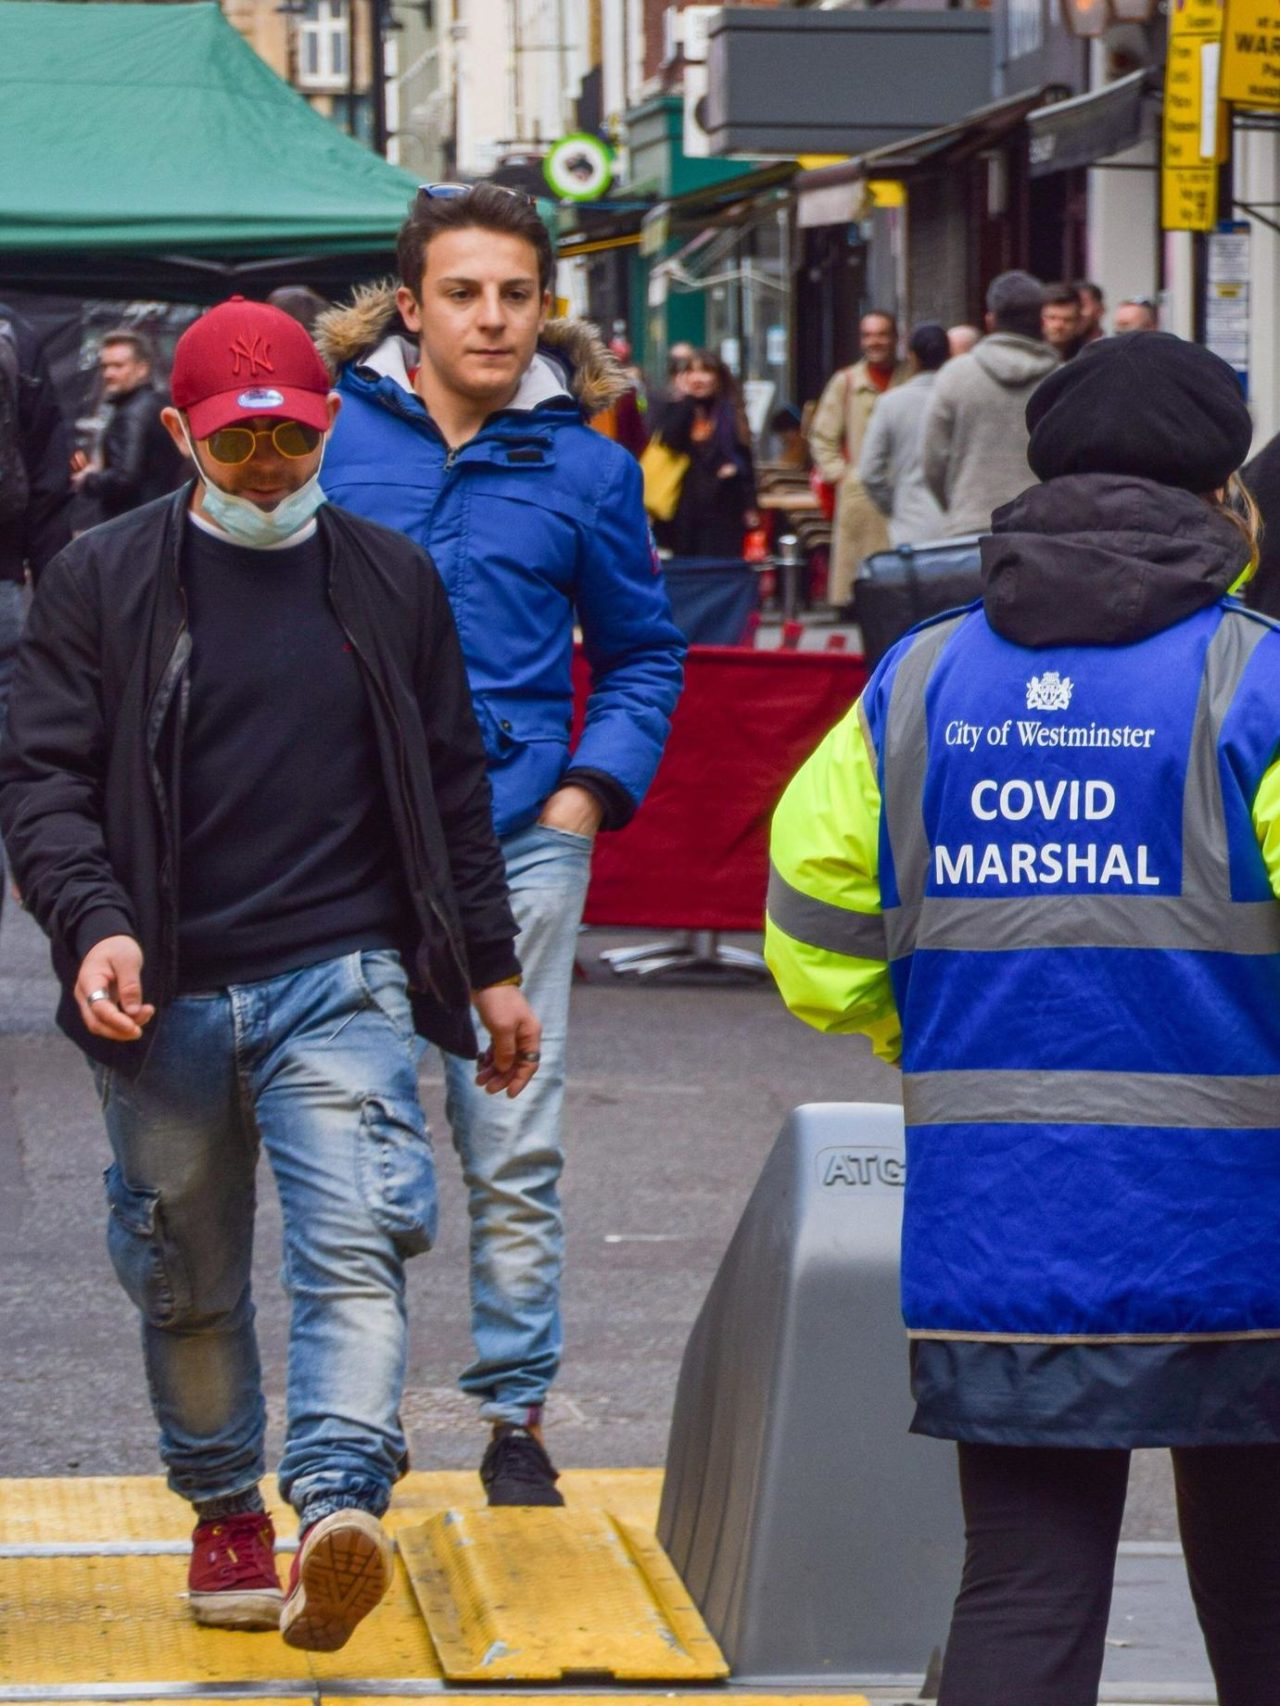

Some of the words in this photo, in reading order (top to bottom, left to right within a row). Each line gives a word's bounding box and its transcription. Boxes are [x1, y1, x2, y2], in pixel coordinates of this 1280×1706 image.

[945, 720, 983, 752] City
[987, 719, 1012, 746] of
[1016, 721, 1156, 748] Westminster
[971, 779, 1116, 821] COVID
[935, 843, 1160, 885] MARSHAL
